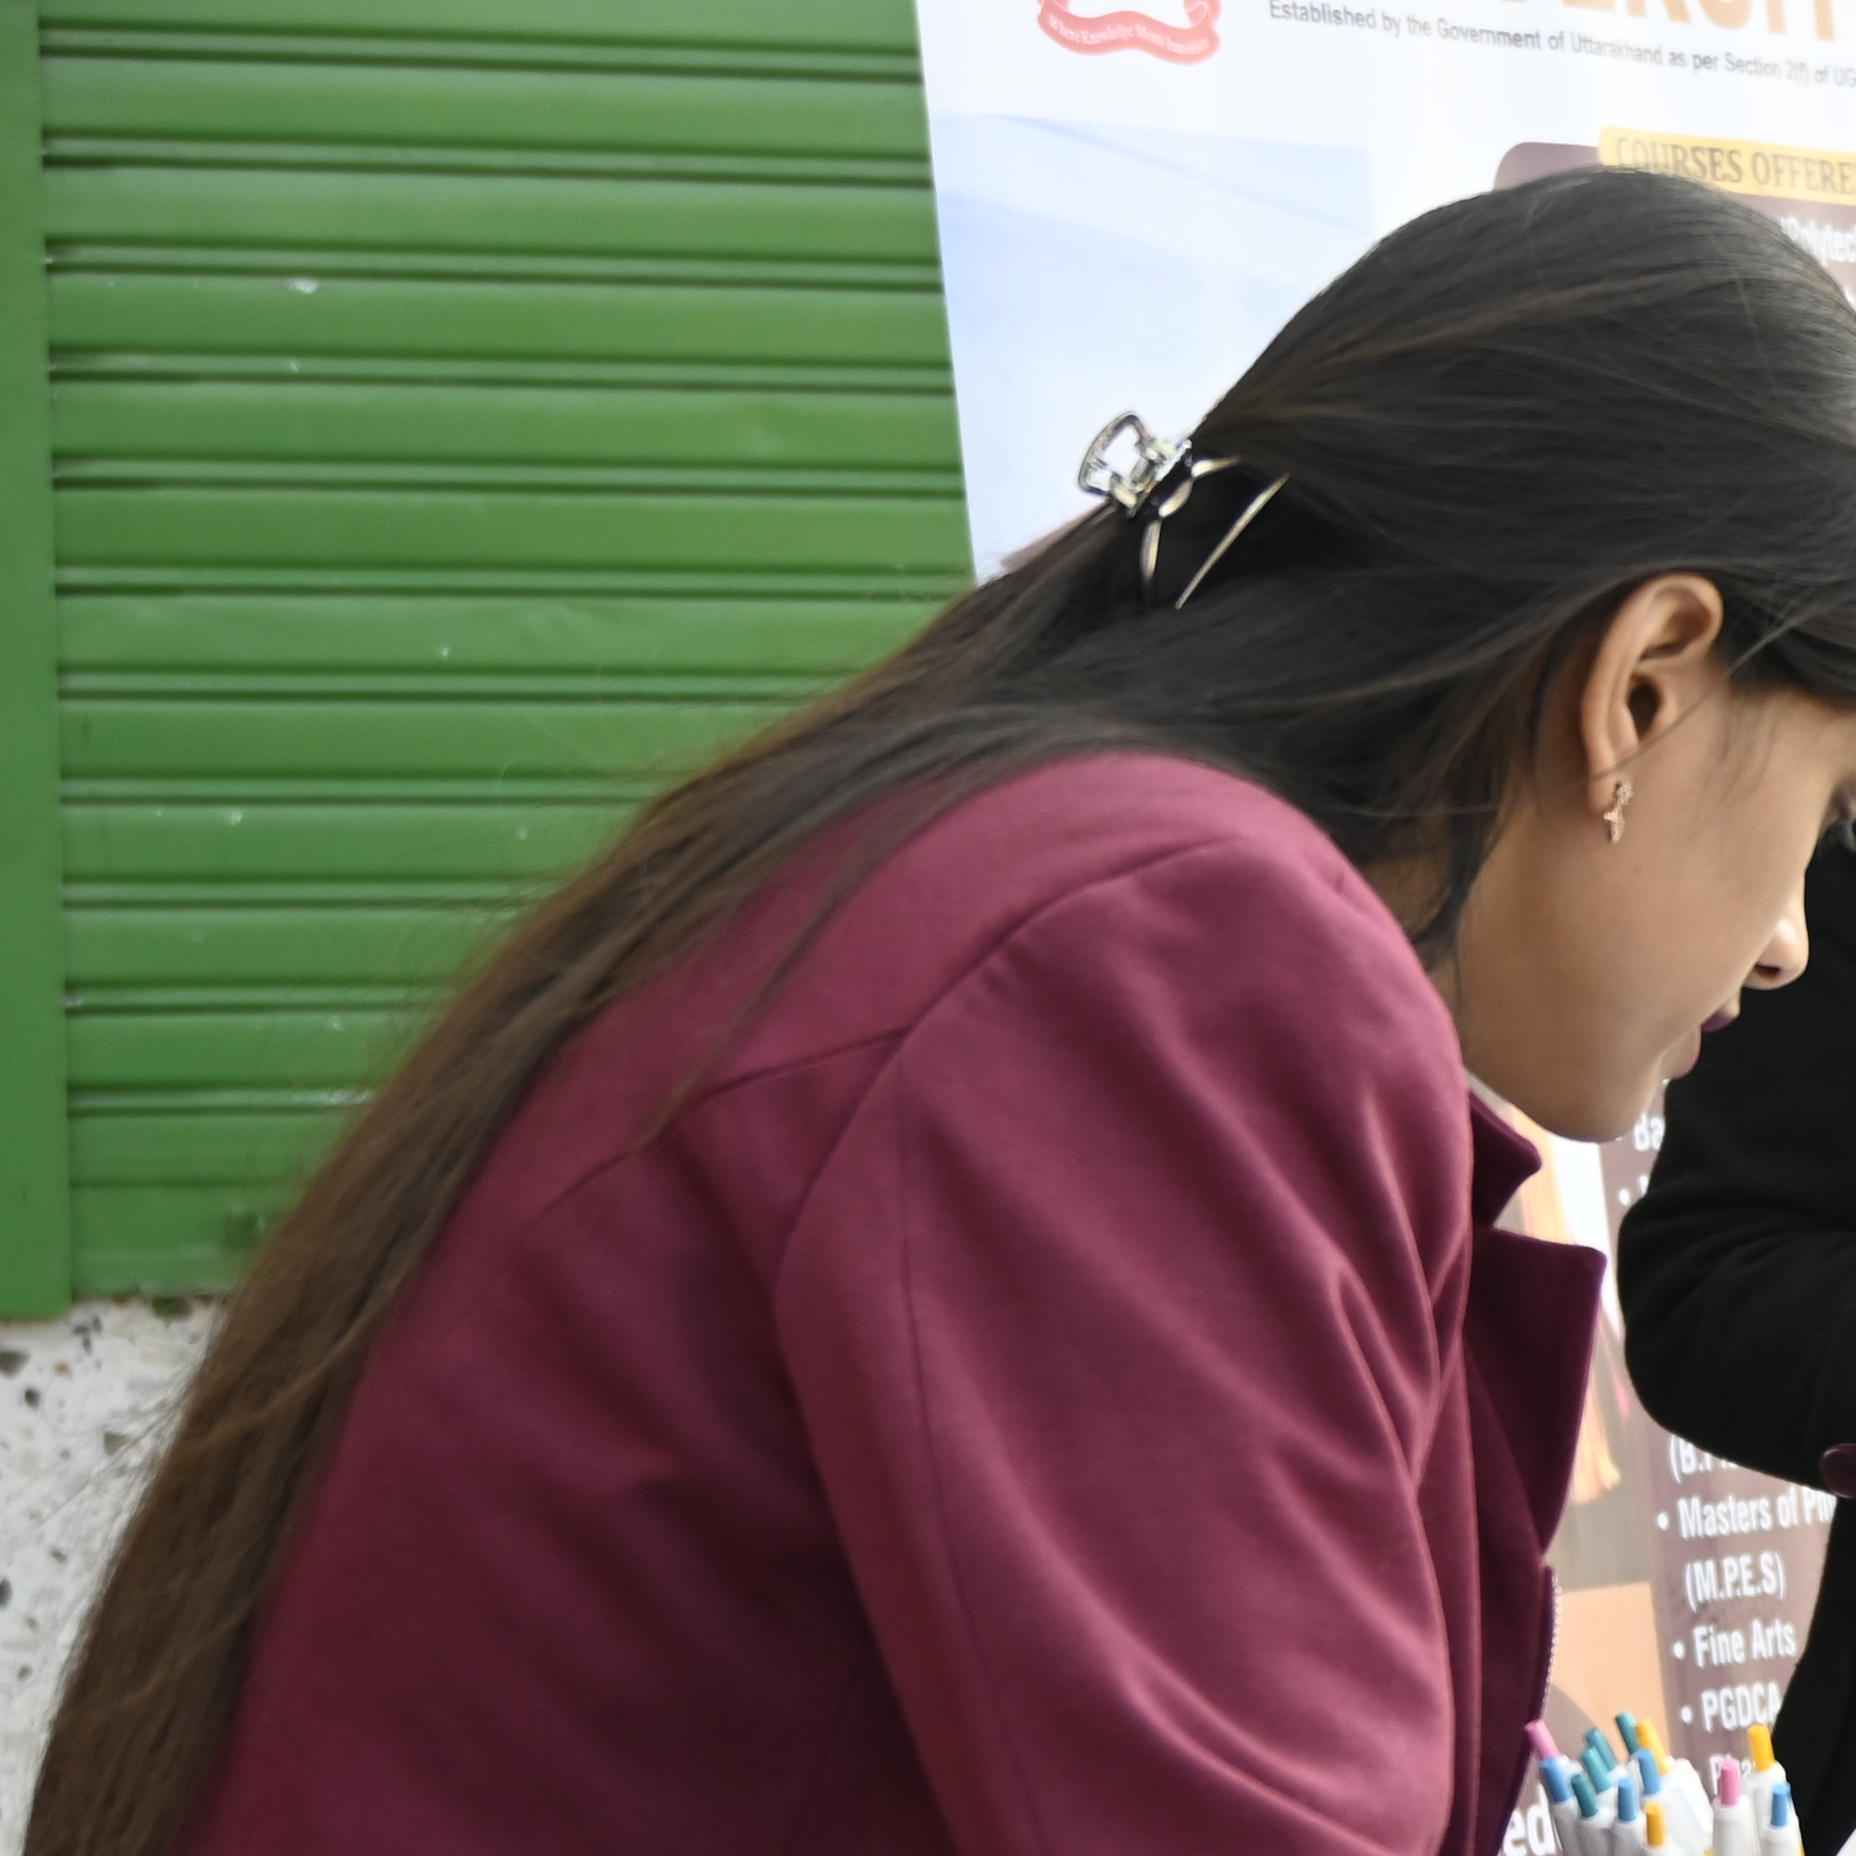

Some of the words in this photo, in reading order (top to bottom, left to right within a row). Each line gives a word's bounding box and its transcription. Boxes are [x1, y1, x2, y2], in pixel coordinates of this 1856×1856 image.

[1269, 0, 1377, 29] Established
[1382, 12, 1401, 38] by
[1406, 14, 1431, 36] the
[1437, 18, 1542, 50] Government
[1548, 31, 1566, 51] of
[1571, 32, 1663, 66] Uttarakhand
[1669, 51, 1687, 68] as
[1692, 52, 1719, 73] per
[1724, 52, 1779, 77] Section
[1814, 65, 1830, 84] of
[1616, 136, 1744, 184] COURSES
[1678, 1494, 1774, 1541] Masters
[1777, 1486, 1799, 1529] of
[1685, 1552, 1788, 1613] (M.P.E.S)
[1693, 1626, 1747, 1669] Fine
[1751, 1618, 1798, 1661] Arts
[1701, 1681, 1782, 1734] PGDCA
